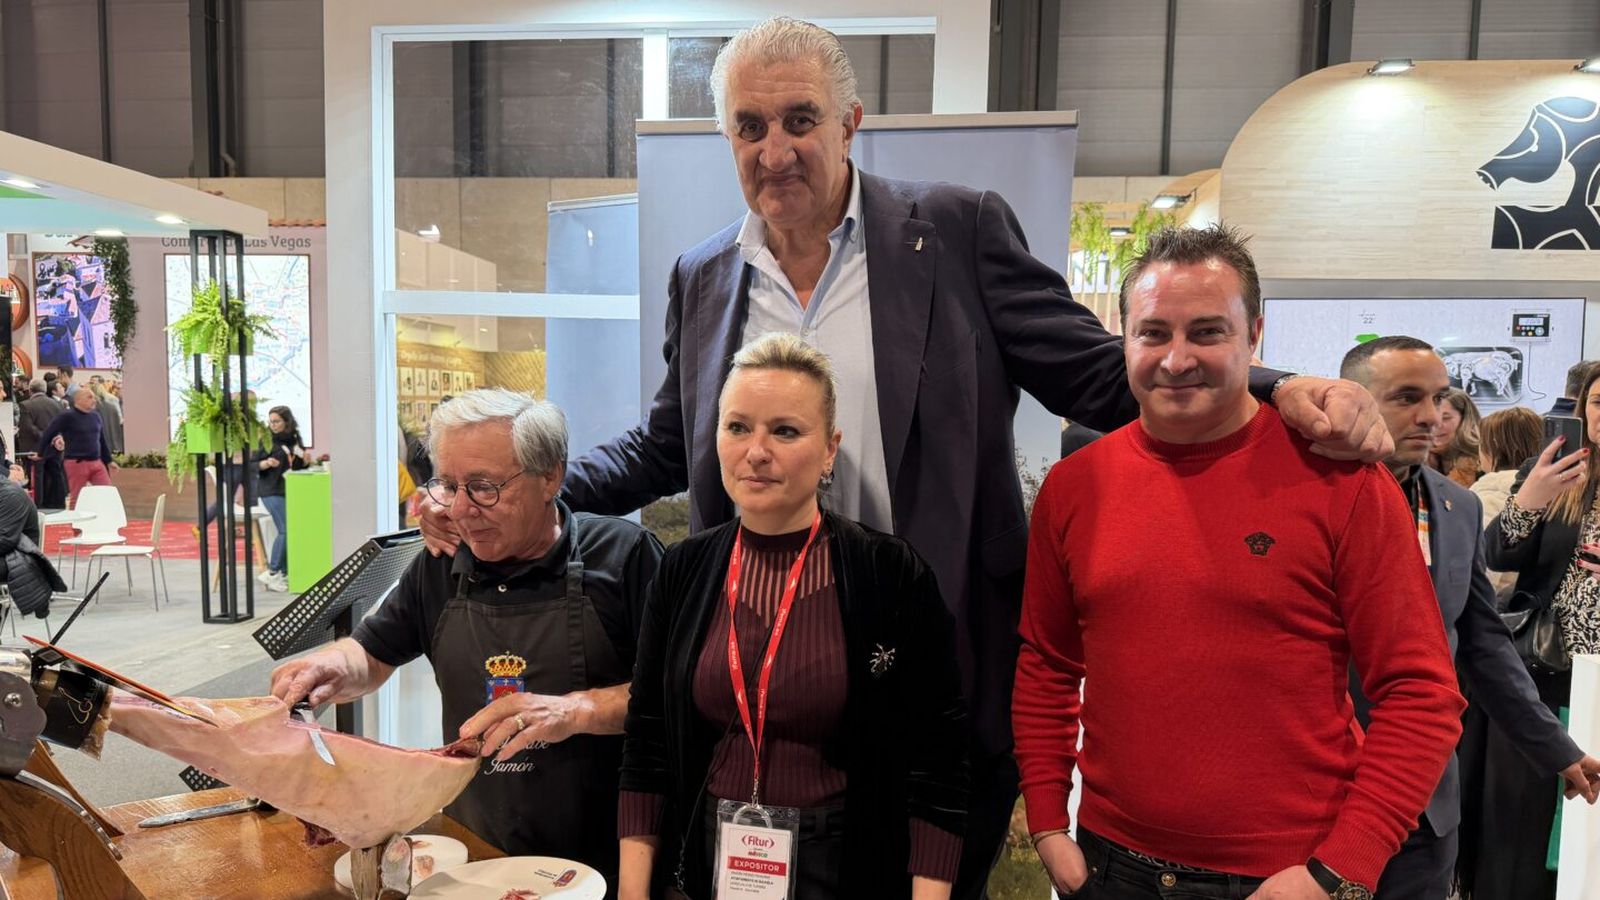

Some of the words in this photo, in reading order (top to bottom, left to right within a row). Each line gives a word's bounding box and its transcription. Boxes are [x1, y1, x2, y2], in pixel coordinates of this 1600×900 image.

[161, 236, 224, 248] Comr
[245, 236, 267, 248] Las
[270, 235, 311, 251] Vegas
[484, 757, 535, 775] Jamón
[734, 860, 780, 872] EXPOSITOR
